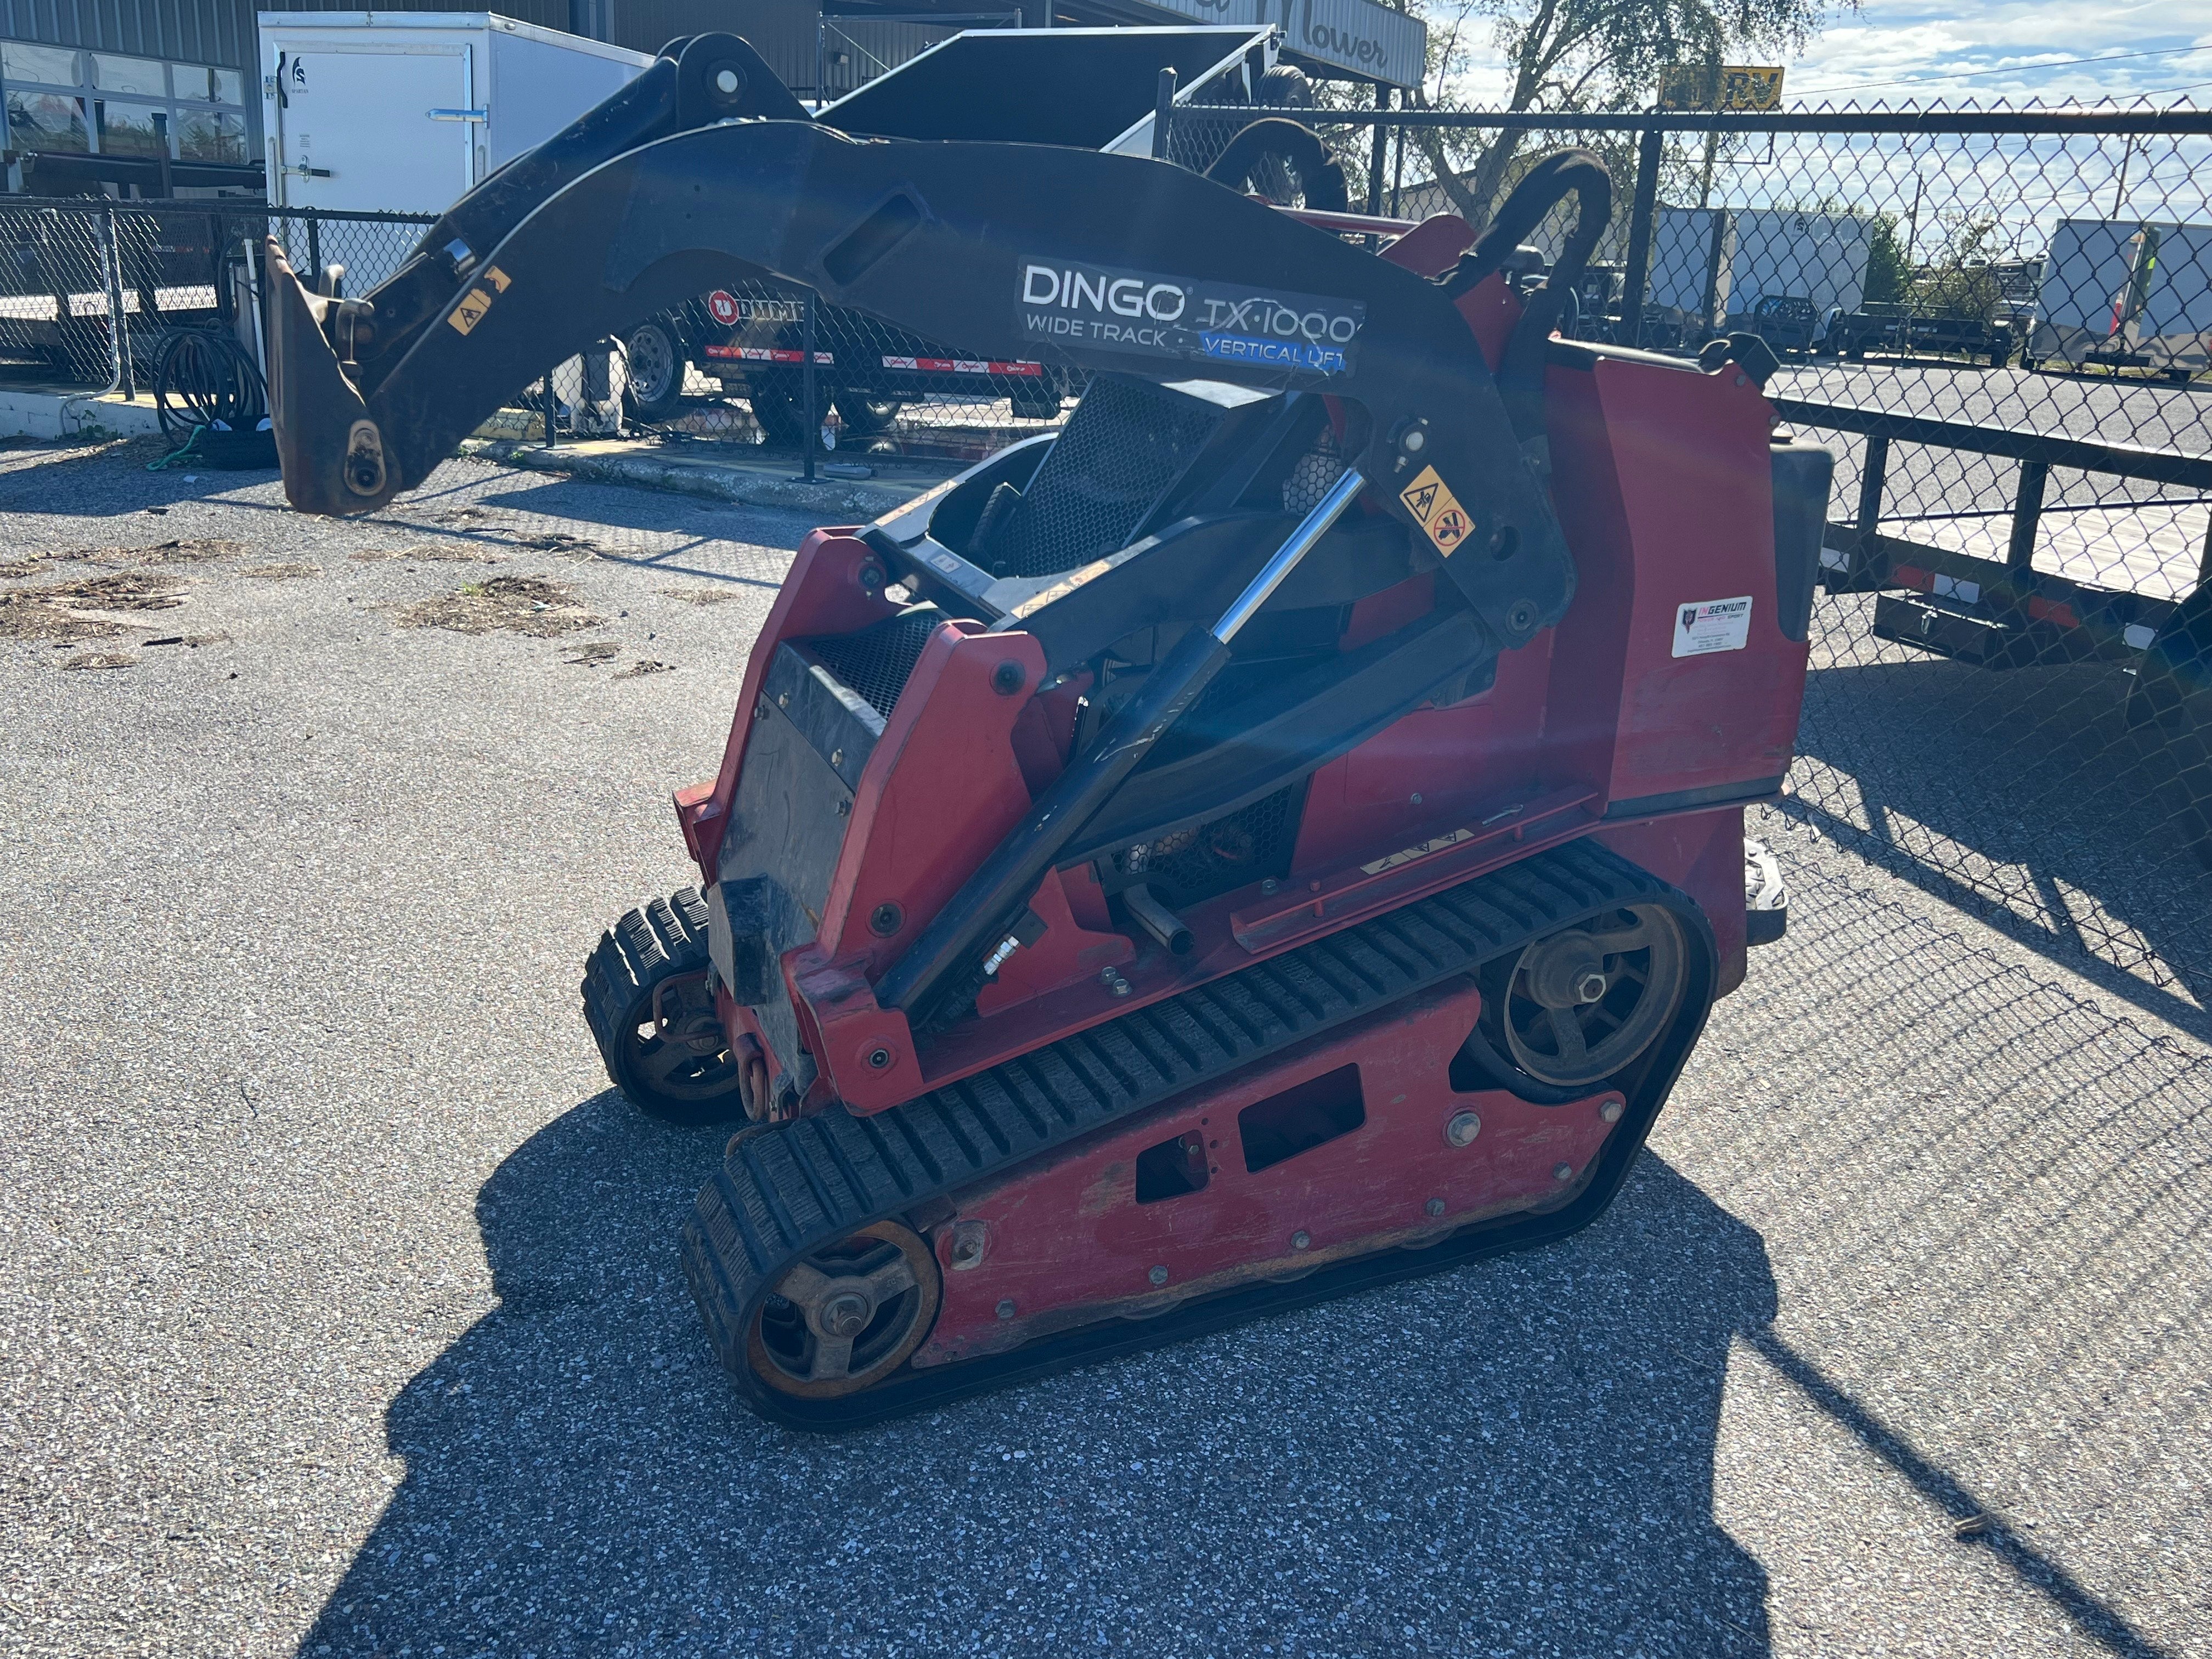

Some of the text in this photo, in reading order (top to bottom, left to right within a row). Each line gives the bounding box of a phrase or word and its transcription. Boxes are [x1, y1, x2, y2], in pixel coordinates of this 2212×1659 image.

[1026, 314, 1084, 337] WIDE
[1090, 321, 1167, 347] TRACK
[1205, 337, 1302, 363] VERTICAL
[1699, 602, 1747, 615] INGENIUM
